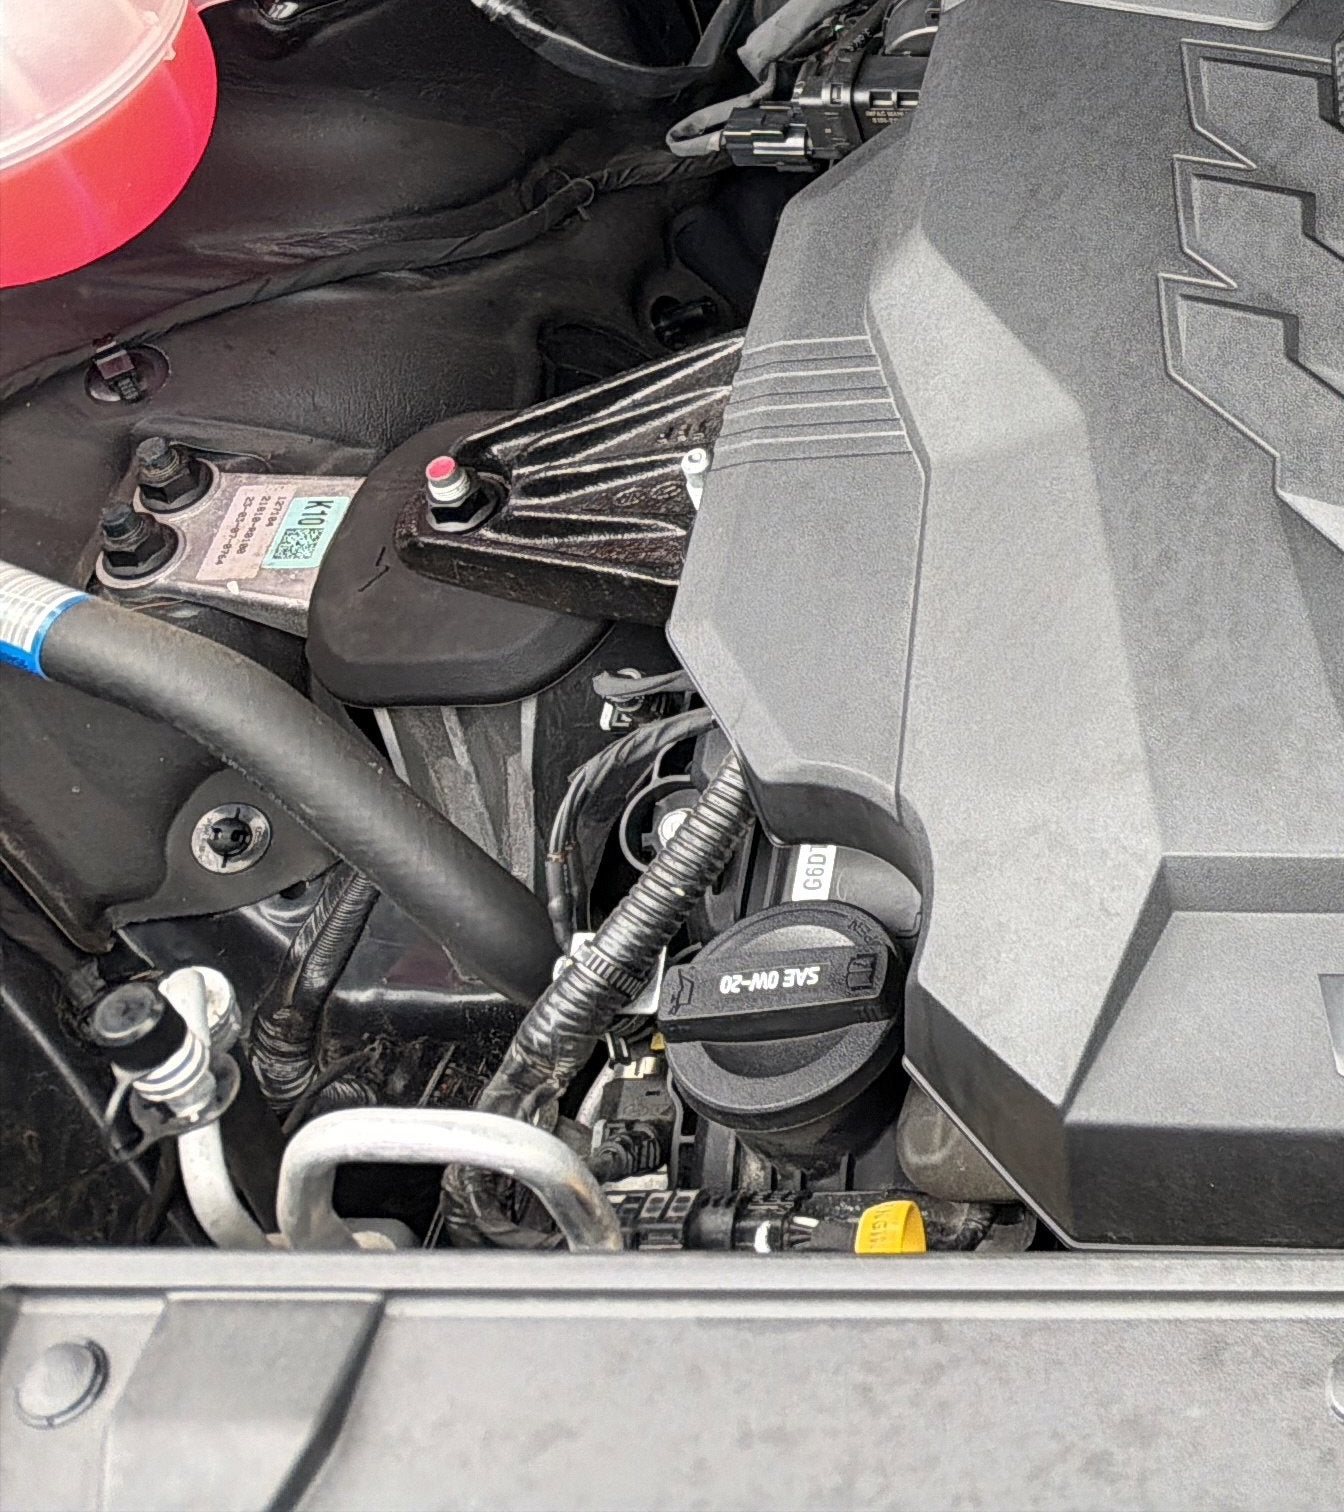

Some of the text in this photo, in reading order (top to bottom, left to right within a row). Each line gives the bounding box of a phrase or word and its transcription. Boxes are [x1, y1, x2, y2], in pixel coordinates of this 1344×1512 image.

[298, 500, 334, 526] K10
[719, 965, 821, 995] SAE 0W-20
